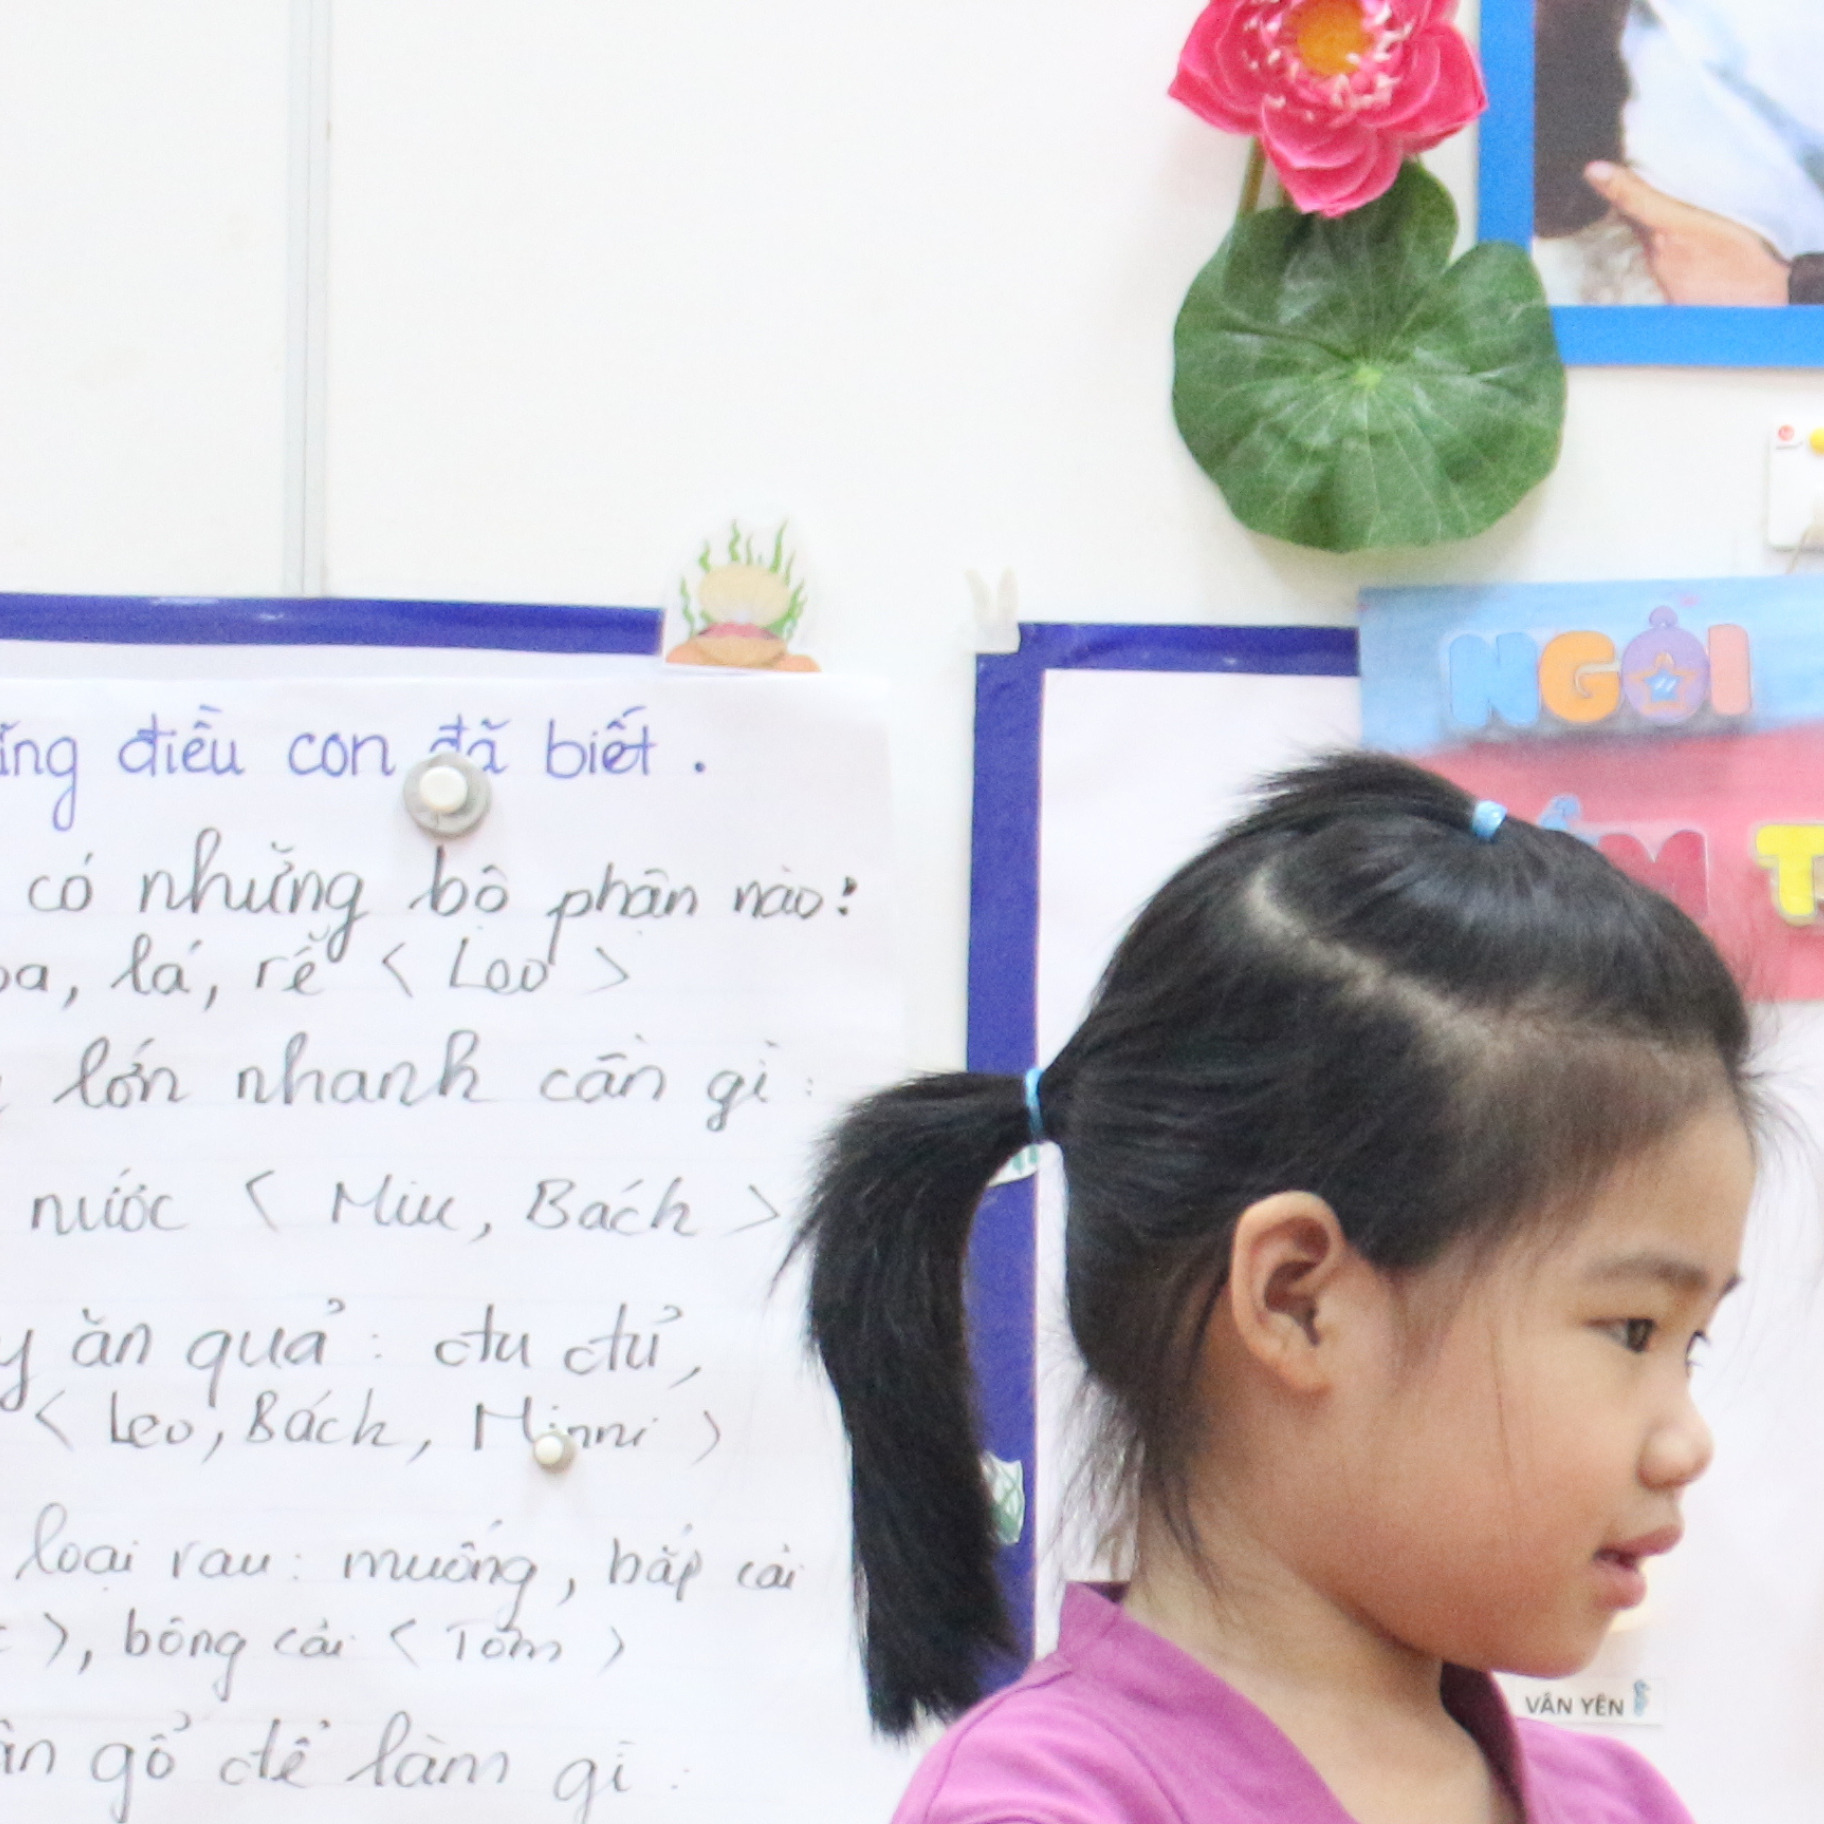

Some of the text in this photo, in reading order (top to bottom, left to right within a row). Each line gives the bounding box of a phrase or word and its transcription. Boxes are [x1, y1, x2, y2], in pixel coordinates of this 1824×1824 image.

[118, 704, 245, 777] điều
[288, 731, 396, 777] con
[28, 852, 94, 912] có
[139, 827, 370, 963] những
[53, 1036, 191, 1110] lớn
[237, 1030, 492, 1106] nhanh
[31, 1168, 190, 1236] nước
[71, 1308, 153, 1368] ăn
[124, 1606, 248, 1702] bông
[346, 1710, 510, 1788] làm
